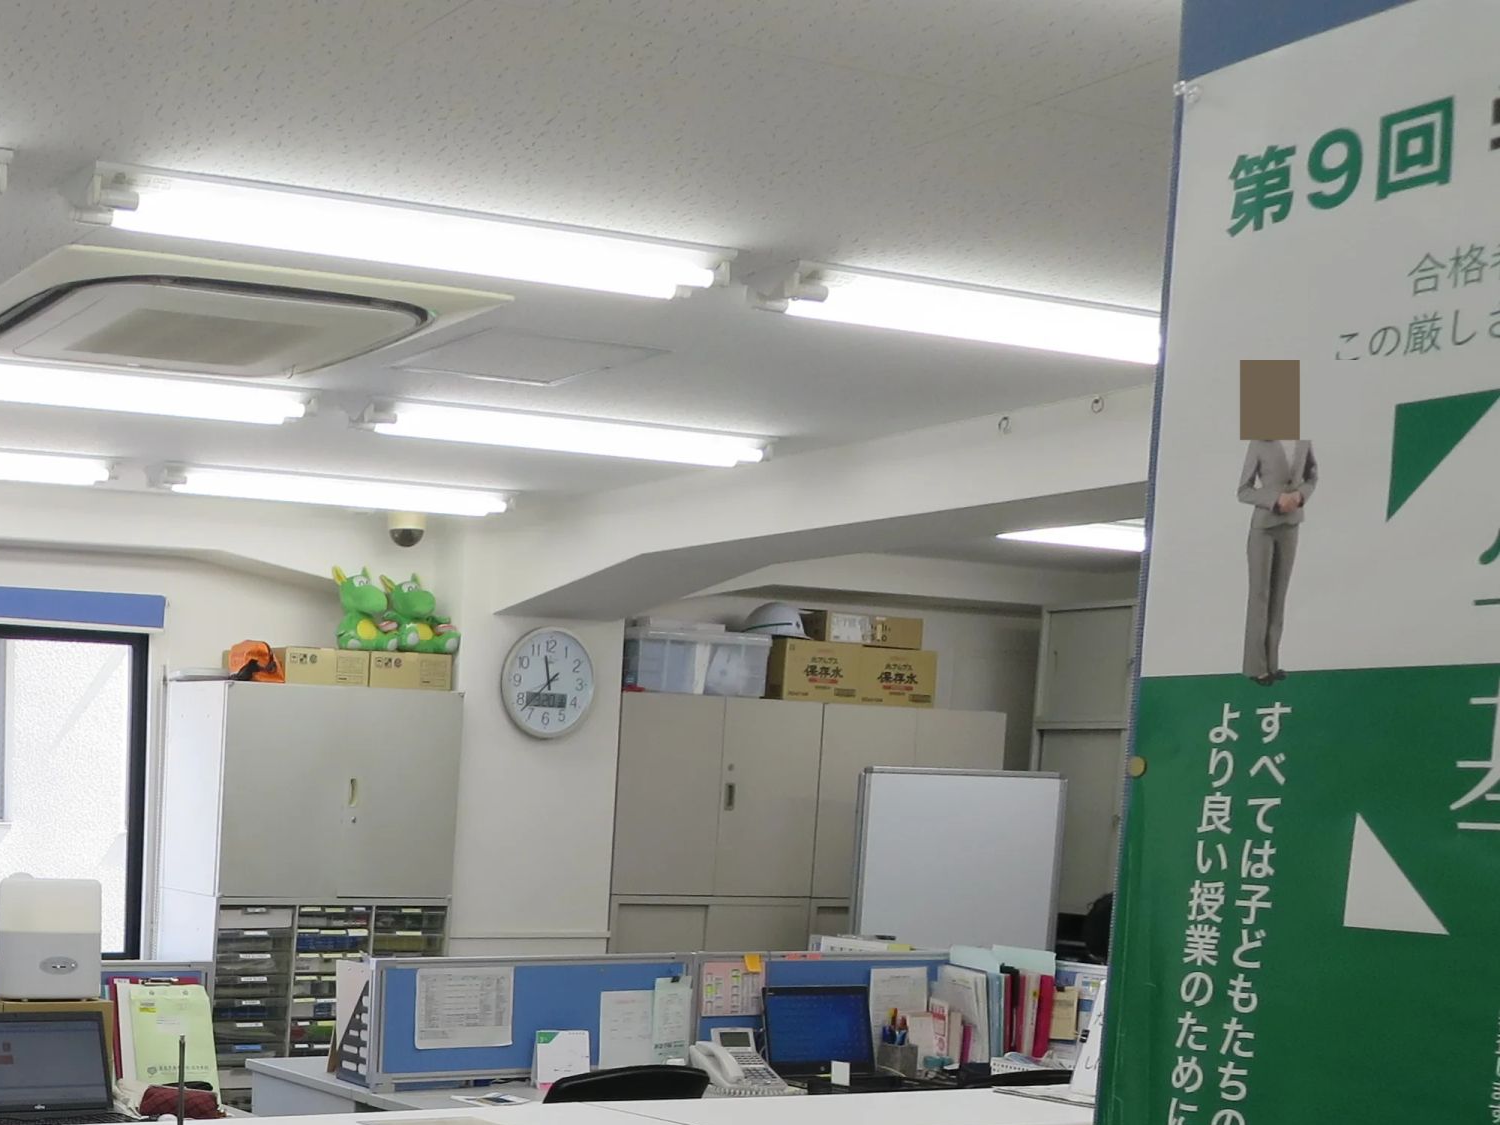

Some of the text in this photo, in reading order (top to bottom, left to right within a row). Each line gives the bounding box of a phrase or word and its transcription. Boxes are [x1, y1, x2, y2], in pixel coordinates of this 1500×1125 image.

[1226, 95, 1455, 237] 第9回
[804, 664, 843, 679] 保存水
[877, 671, 918, 685] 保存水
